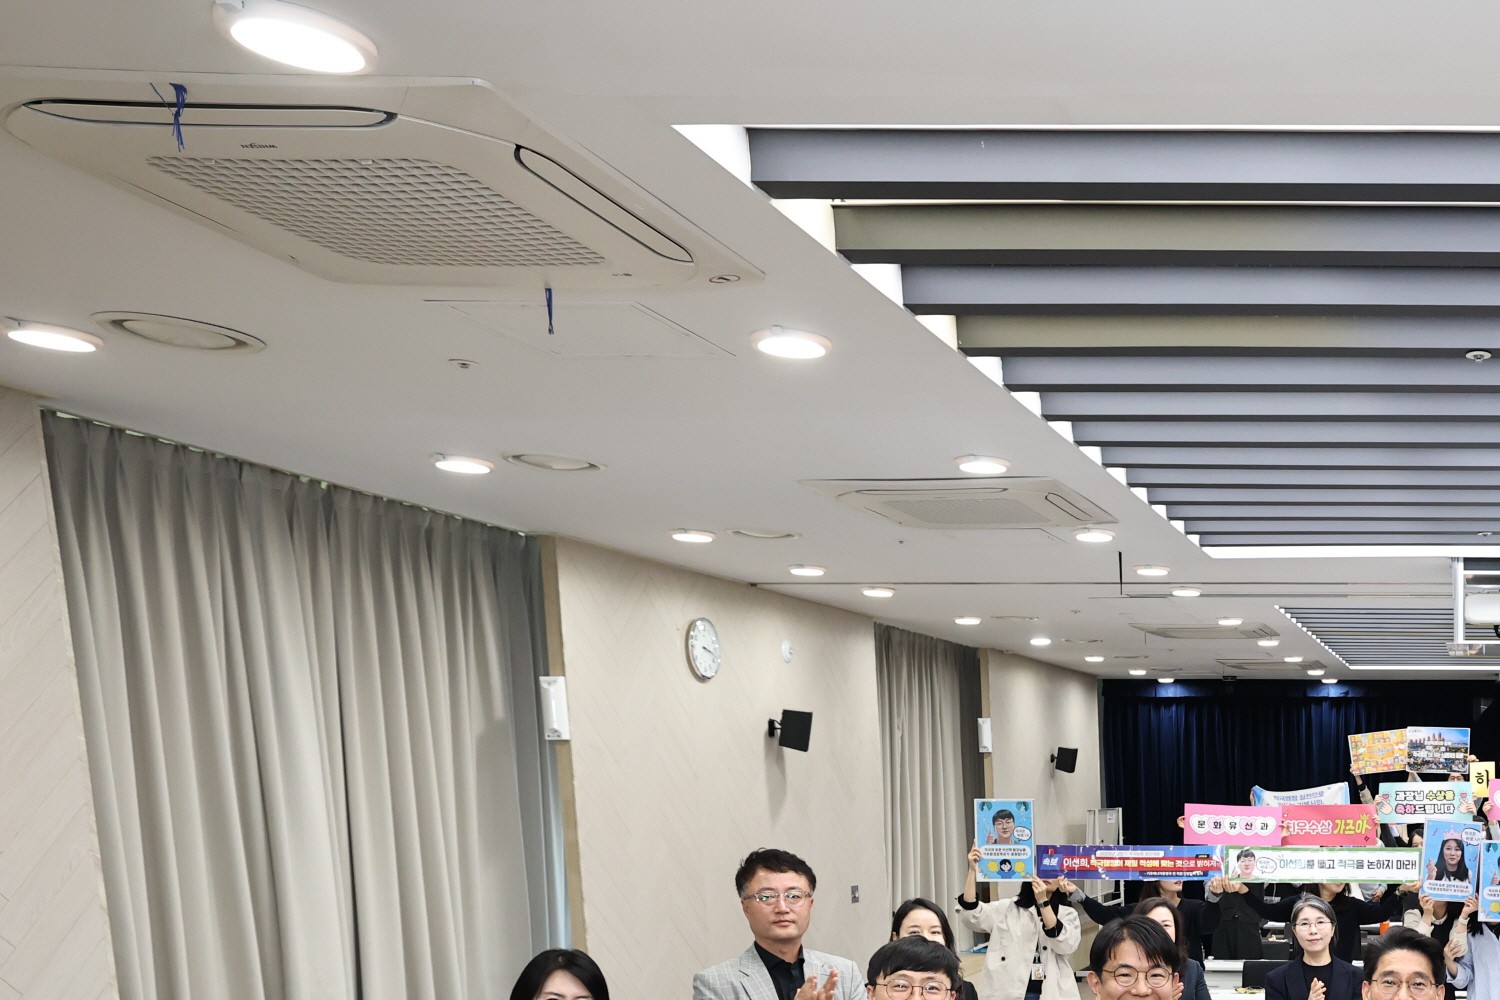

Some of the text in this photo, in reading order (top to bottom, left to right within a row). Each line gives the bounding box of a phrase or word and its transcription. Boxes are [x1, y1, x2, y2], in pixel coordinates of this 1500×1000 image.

[1394, 790, 1455, 801] 과장님 수상을
[1394, 804, 1455, 815] 축하드립니다
[1197, 820, 1268, 831] 문화유산과
[1042, 857, 1059, 866] 속보
[1063, 858, 1090, 868] 이선희,
[1338, 859, 1364, 870] 적극을
[1367, 859, 1394, 871] 논하지
[1396, 860, 1417, 871] 마라!
